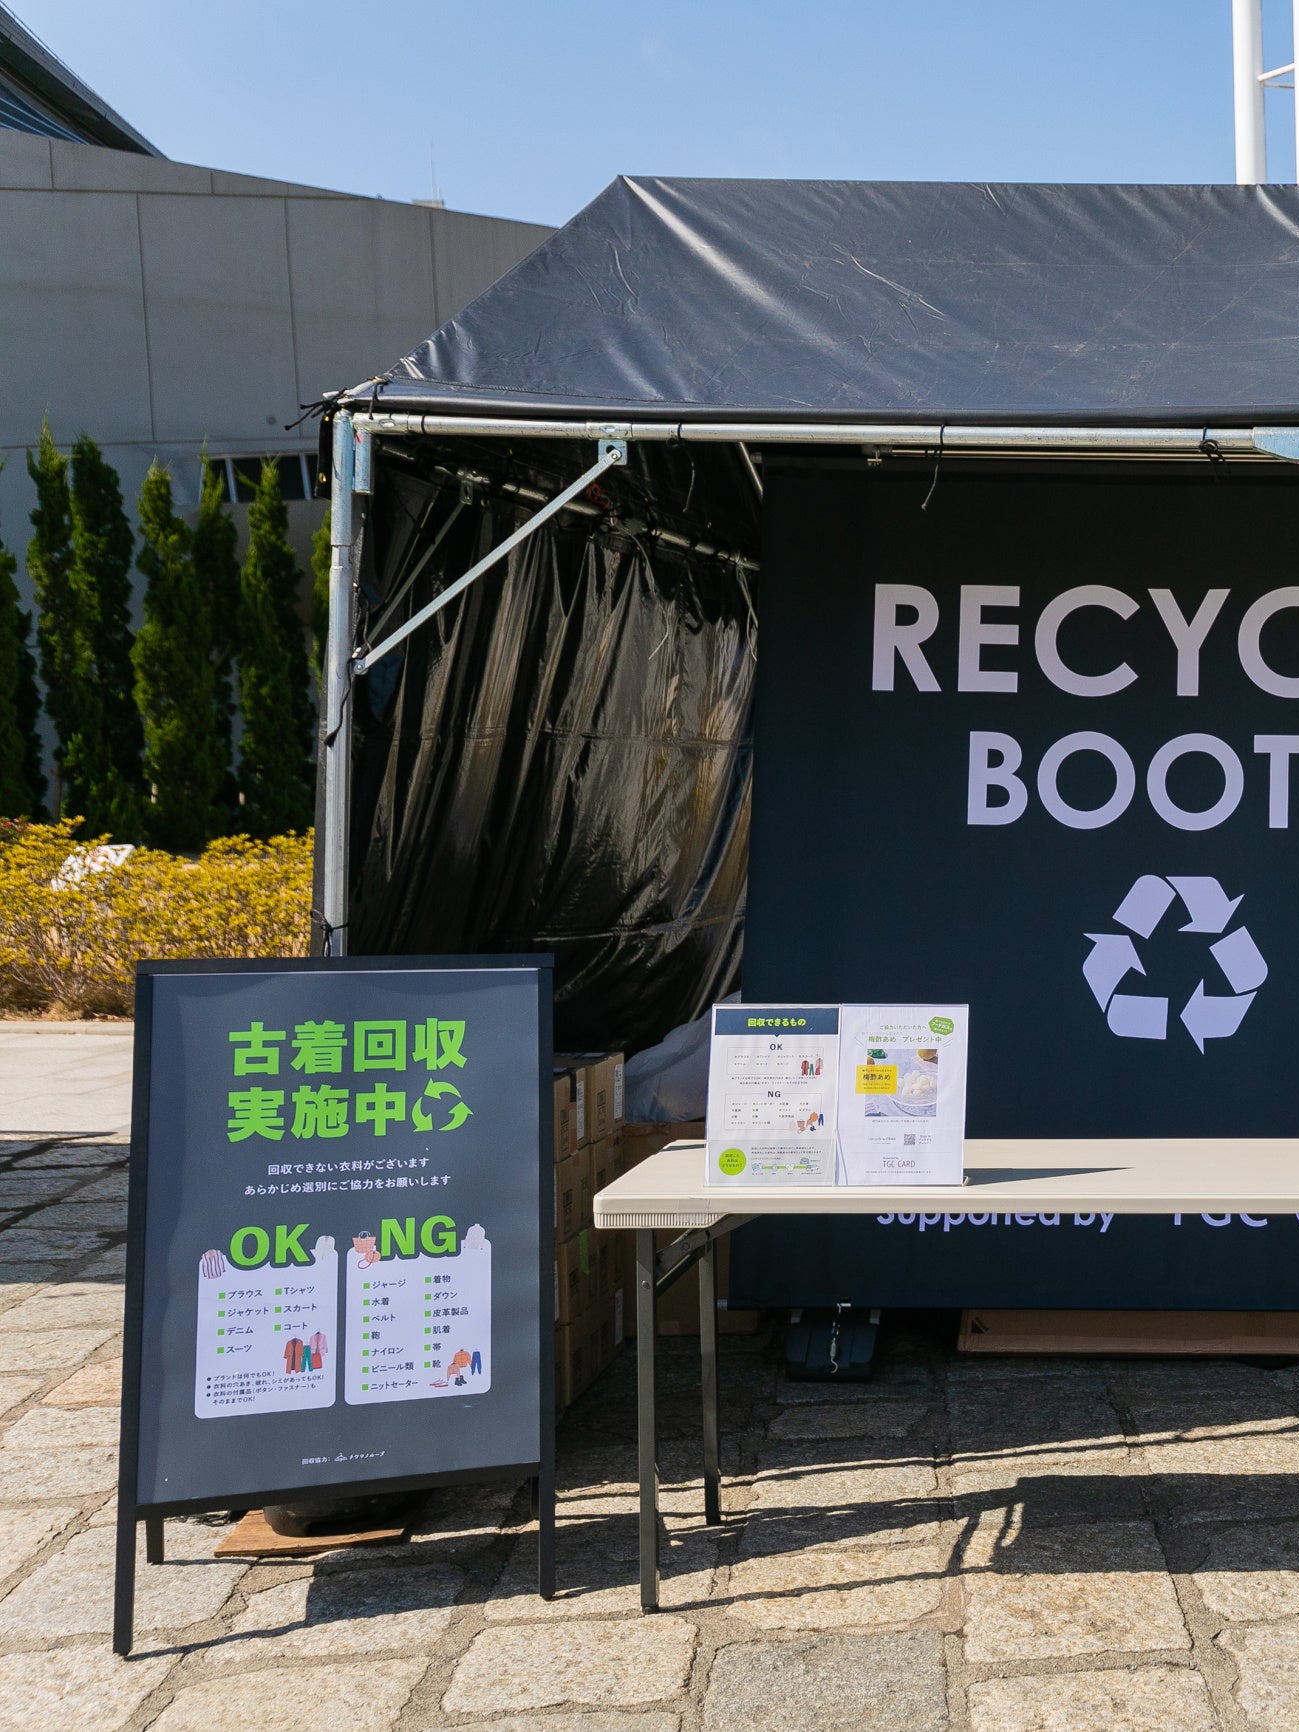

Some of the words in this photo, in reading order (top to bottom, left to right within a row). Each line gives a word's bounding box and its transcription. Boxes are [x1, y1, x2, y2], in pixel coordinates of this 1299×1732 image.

[747, 1017, 807, 1028] 回収できるもの
[902, 1035, 942, 1043] プレゼント中
[228, 1017, 467, 1077] 古着回収
[769, 1043, 783, 1051] OK
[767, 1090, 781, 1098] NG
[226, 1082, 407, 1144] 実施中
[267, 1157, 430, 1176] 回収できない衣料がございます
[882, 1160, 896, 1168] TGC
[897, 1160, 916, 1168] CARD
[244, 1174, 452, 1196] あらかじめ選別にご協力をお願いします
[379, 1214, 459, 1258] NG
[229, 1223, 311, 1267] OK
[432, 1274, 451, 1284] 着物
[371, 1279, 407, 1290] ジャージ
[227, 1289, 263, 1300] ブラウス
[283, 1285, 315, 1296] Tシャツ
[433, 1291, 458, 1301] ダウン
[370, 1297, 390, 1307] 水着
[226, 1306, 269, 1318] ジャケット
[283, 1303, 318, 1313] スカート
[432, 1306, 469, 1318] 皮革製品
[371, 1313, 396, 1322] ベルト
[226, 1326, 254, 1336] デニム
[283, 1322, 308, 1331] コート
[432, 1325, 451, 1335] 肌着
[225, 1344, 253, 1354] スーツ
[370, 1346, 404, 1357] ナイロン
[432, 1342, 441, 1352] 帯
[371, 1361, 415, 1373] ビニール類
[432, 1359, 441, 1369] 靴
[370, 1379, 418, 1391] ニットセーター
